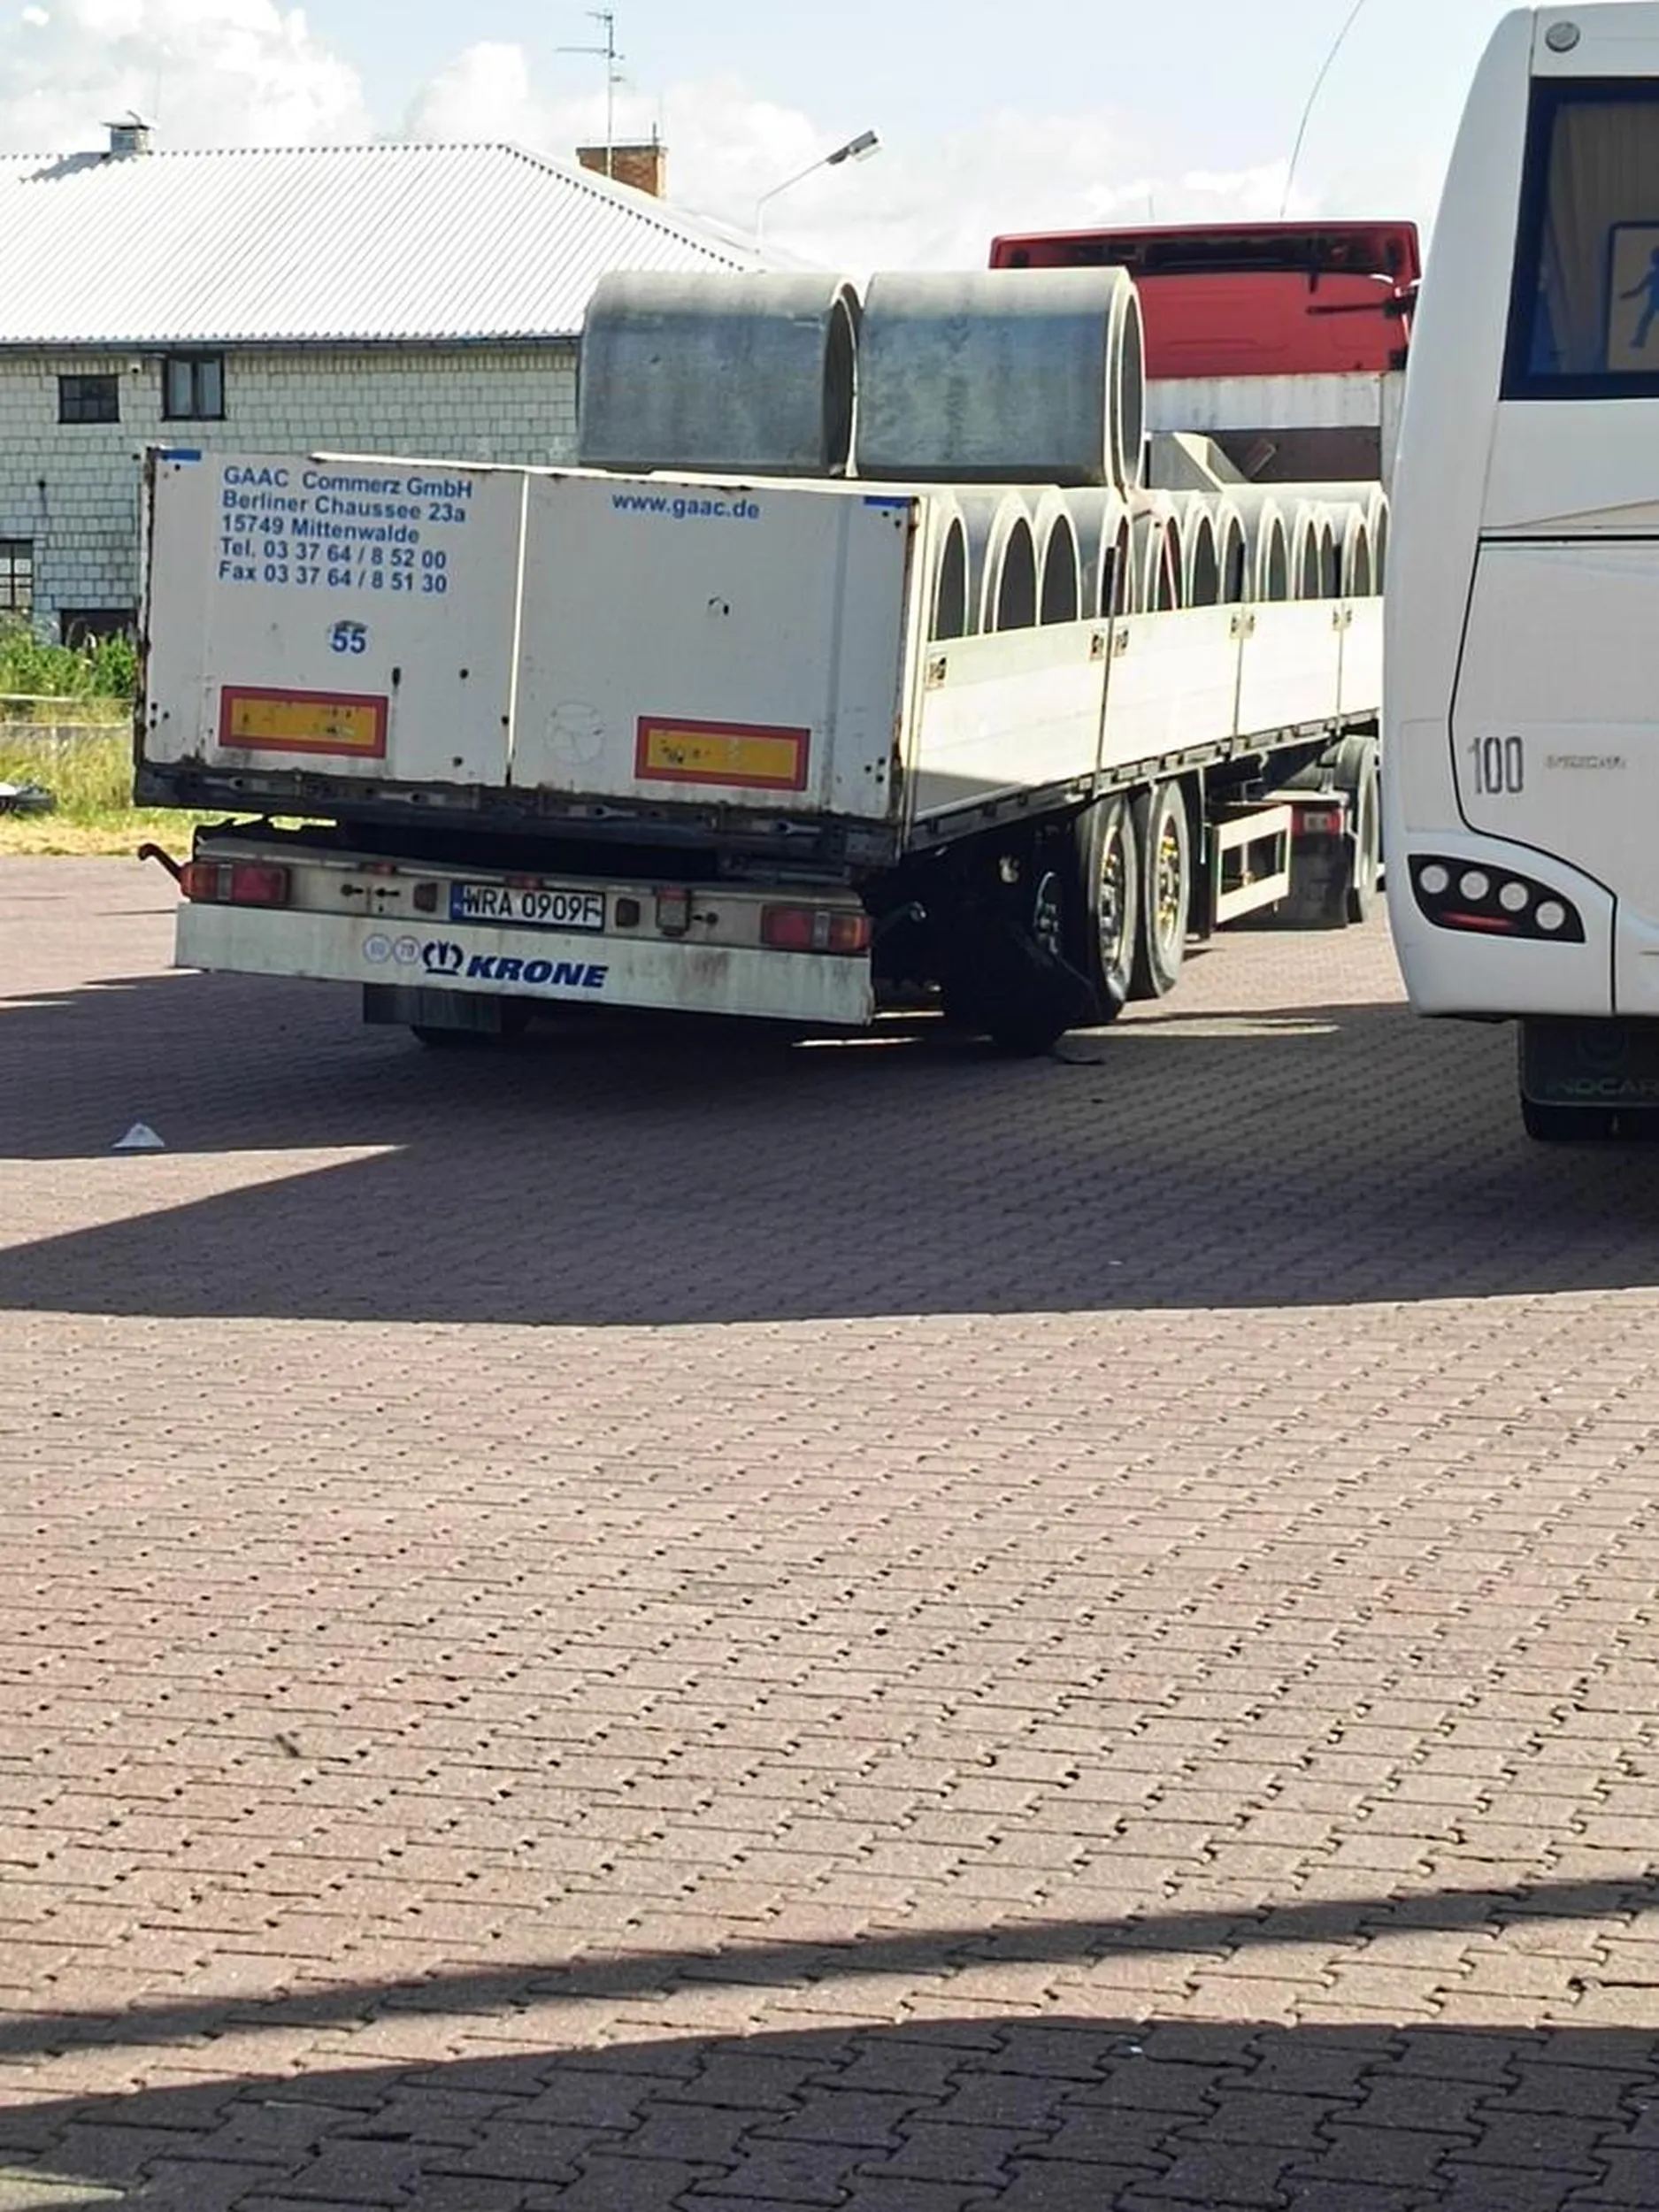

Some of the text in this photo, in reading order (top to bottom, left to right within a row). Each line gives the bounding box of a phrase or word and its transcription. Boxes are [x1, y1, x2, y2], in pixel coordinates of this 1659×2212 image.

[224, 466, 472, 498] GAAC Commerz GmbH
[223, 490, 466, 522] Berliner Chaussee 23a
[612, 495, 760, 518] www.gaac.de
[223, 514, 419, 544] 15749 Mittenwalde
[220, 538, 447, 570] Tel. 03 37 64 / 8 52 00
[219, 560, 448, 594] Fax 03 37 64 / 8 51 30
[331, 623, 367, 654] 55
[1467, 736, 1524, 794] 100
[463, 887, 512, 917] WRA
[466, 955, 609, 988] KRONE
